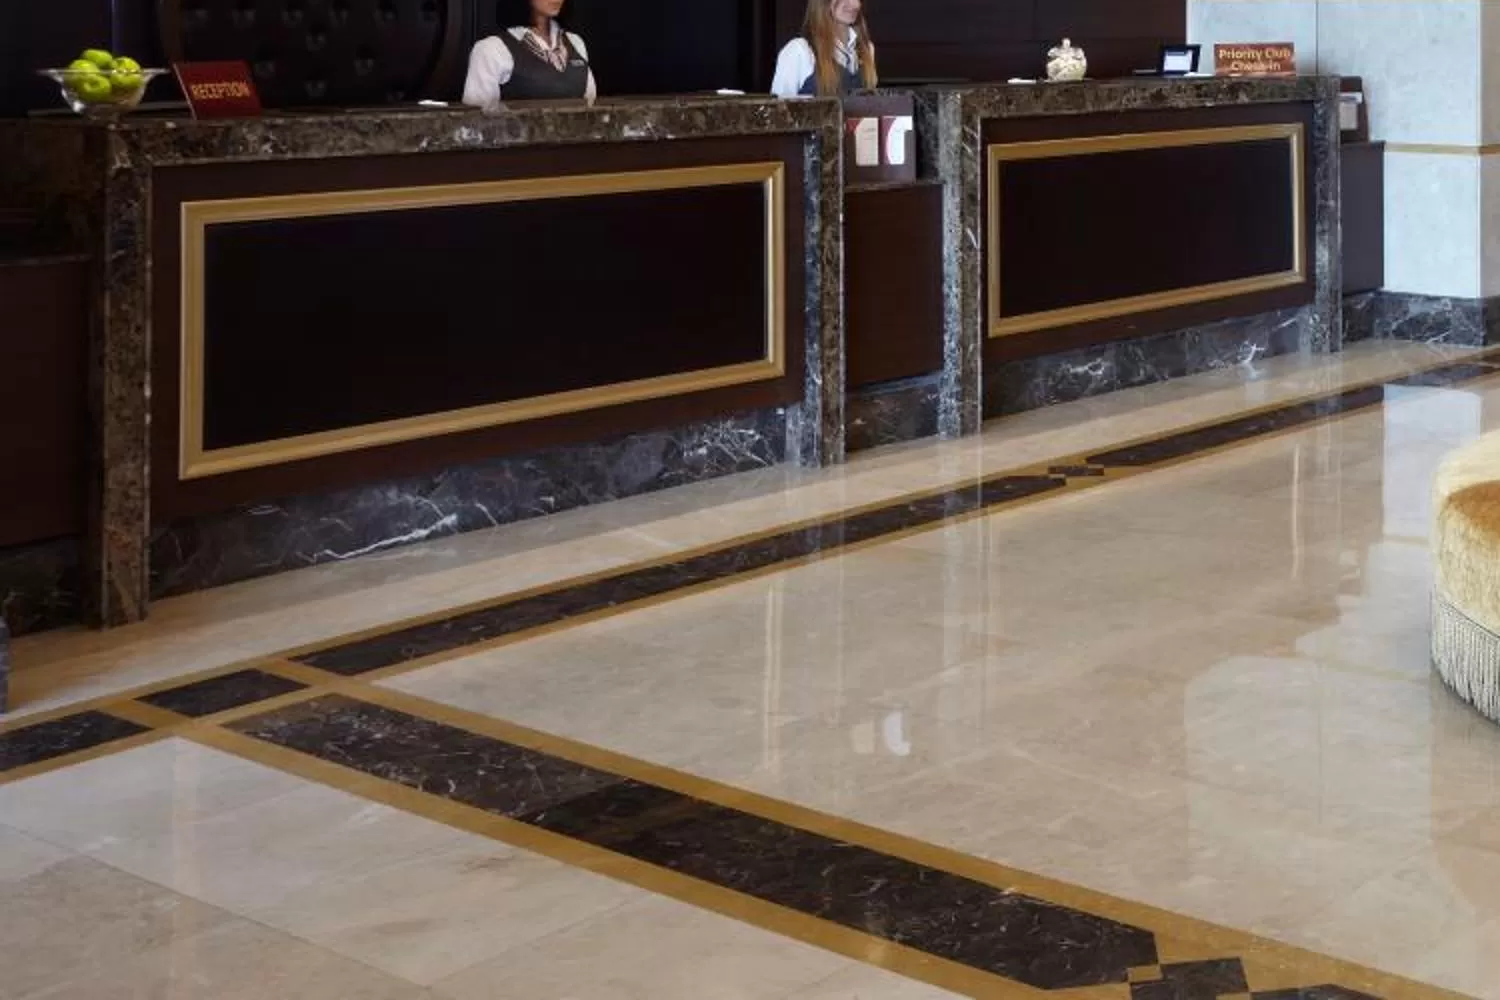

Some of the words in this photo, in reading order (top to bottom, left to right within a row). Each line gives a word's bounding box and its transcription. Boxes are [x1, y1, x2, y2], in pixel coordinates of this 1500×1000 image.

[1219, 47, 1262, 61] Priority
[1265, 47, 1291, 59] Club
[191, 81, 250, 99] RECEPTION
